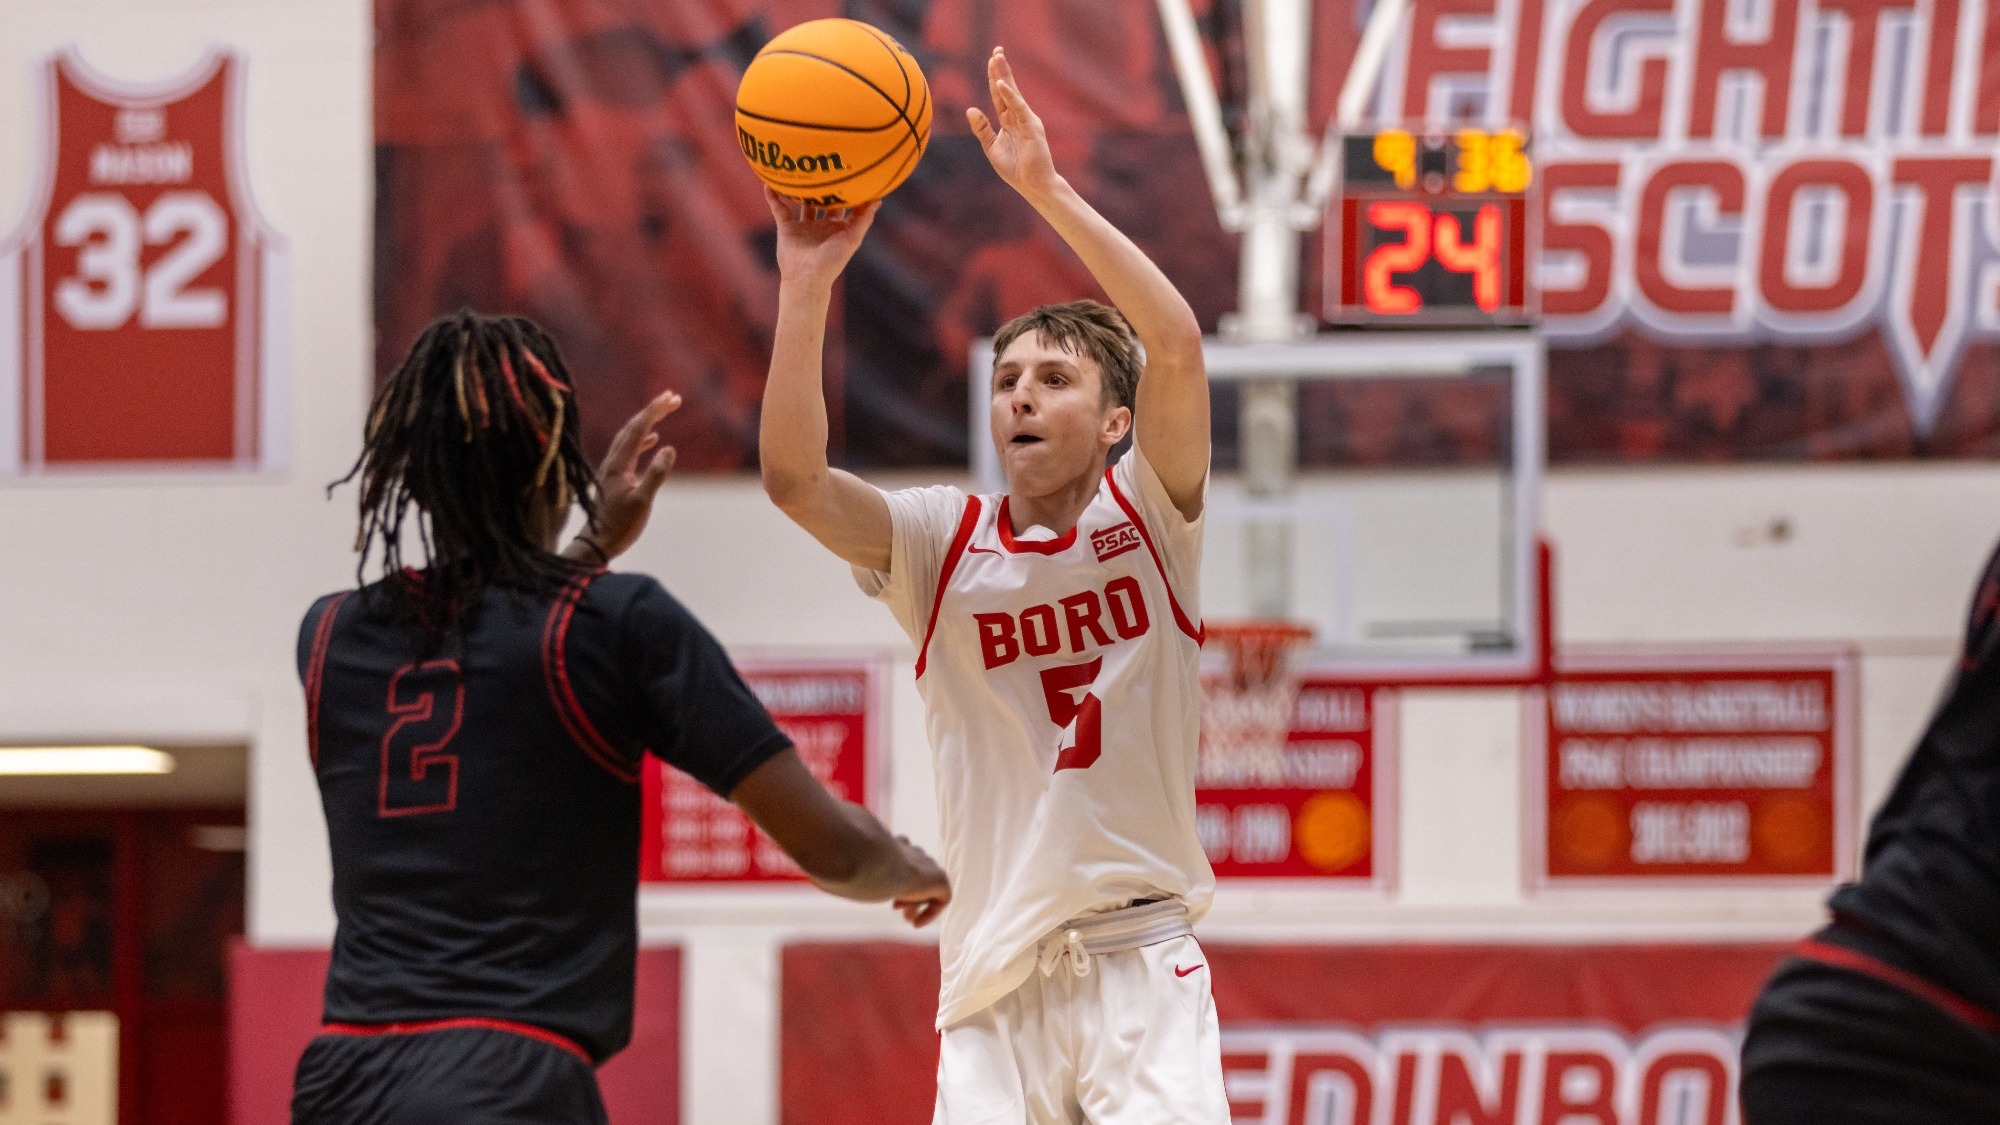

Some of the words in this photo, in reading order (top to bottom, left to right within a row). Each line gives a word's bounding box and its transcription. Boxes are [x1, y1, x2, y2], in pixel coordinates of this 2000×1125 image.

[738, 125, 844, 173] Wilson
[53, 191, 230, 331] 32
[1364, 201, 1501, 314] 24
[1540, 157, 2000, 362] SCOT
[1092, 527, 1140, 555] PSAC
[973, 575, 1150, 671] BORO
[378, 659, 466, 818] 2
[1039, 654, 1103, 776] 5
